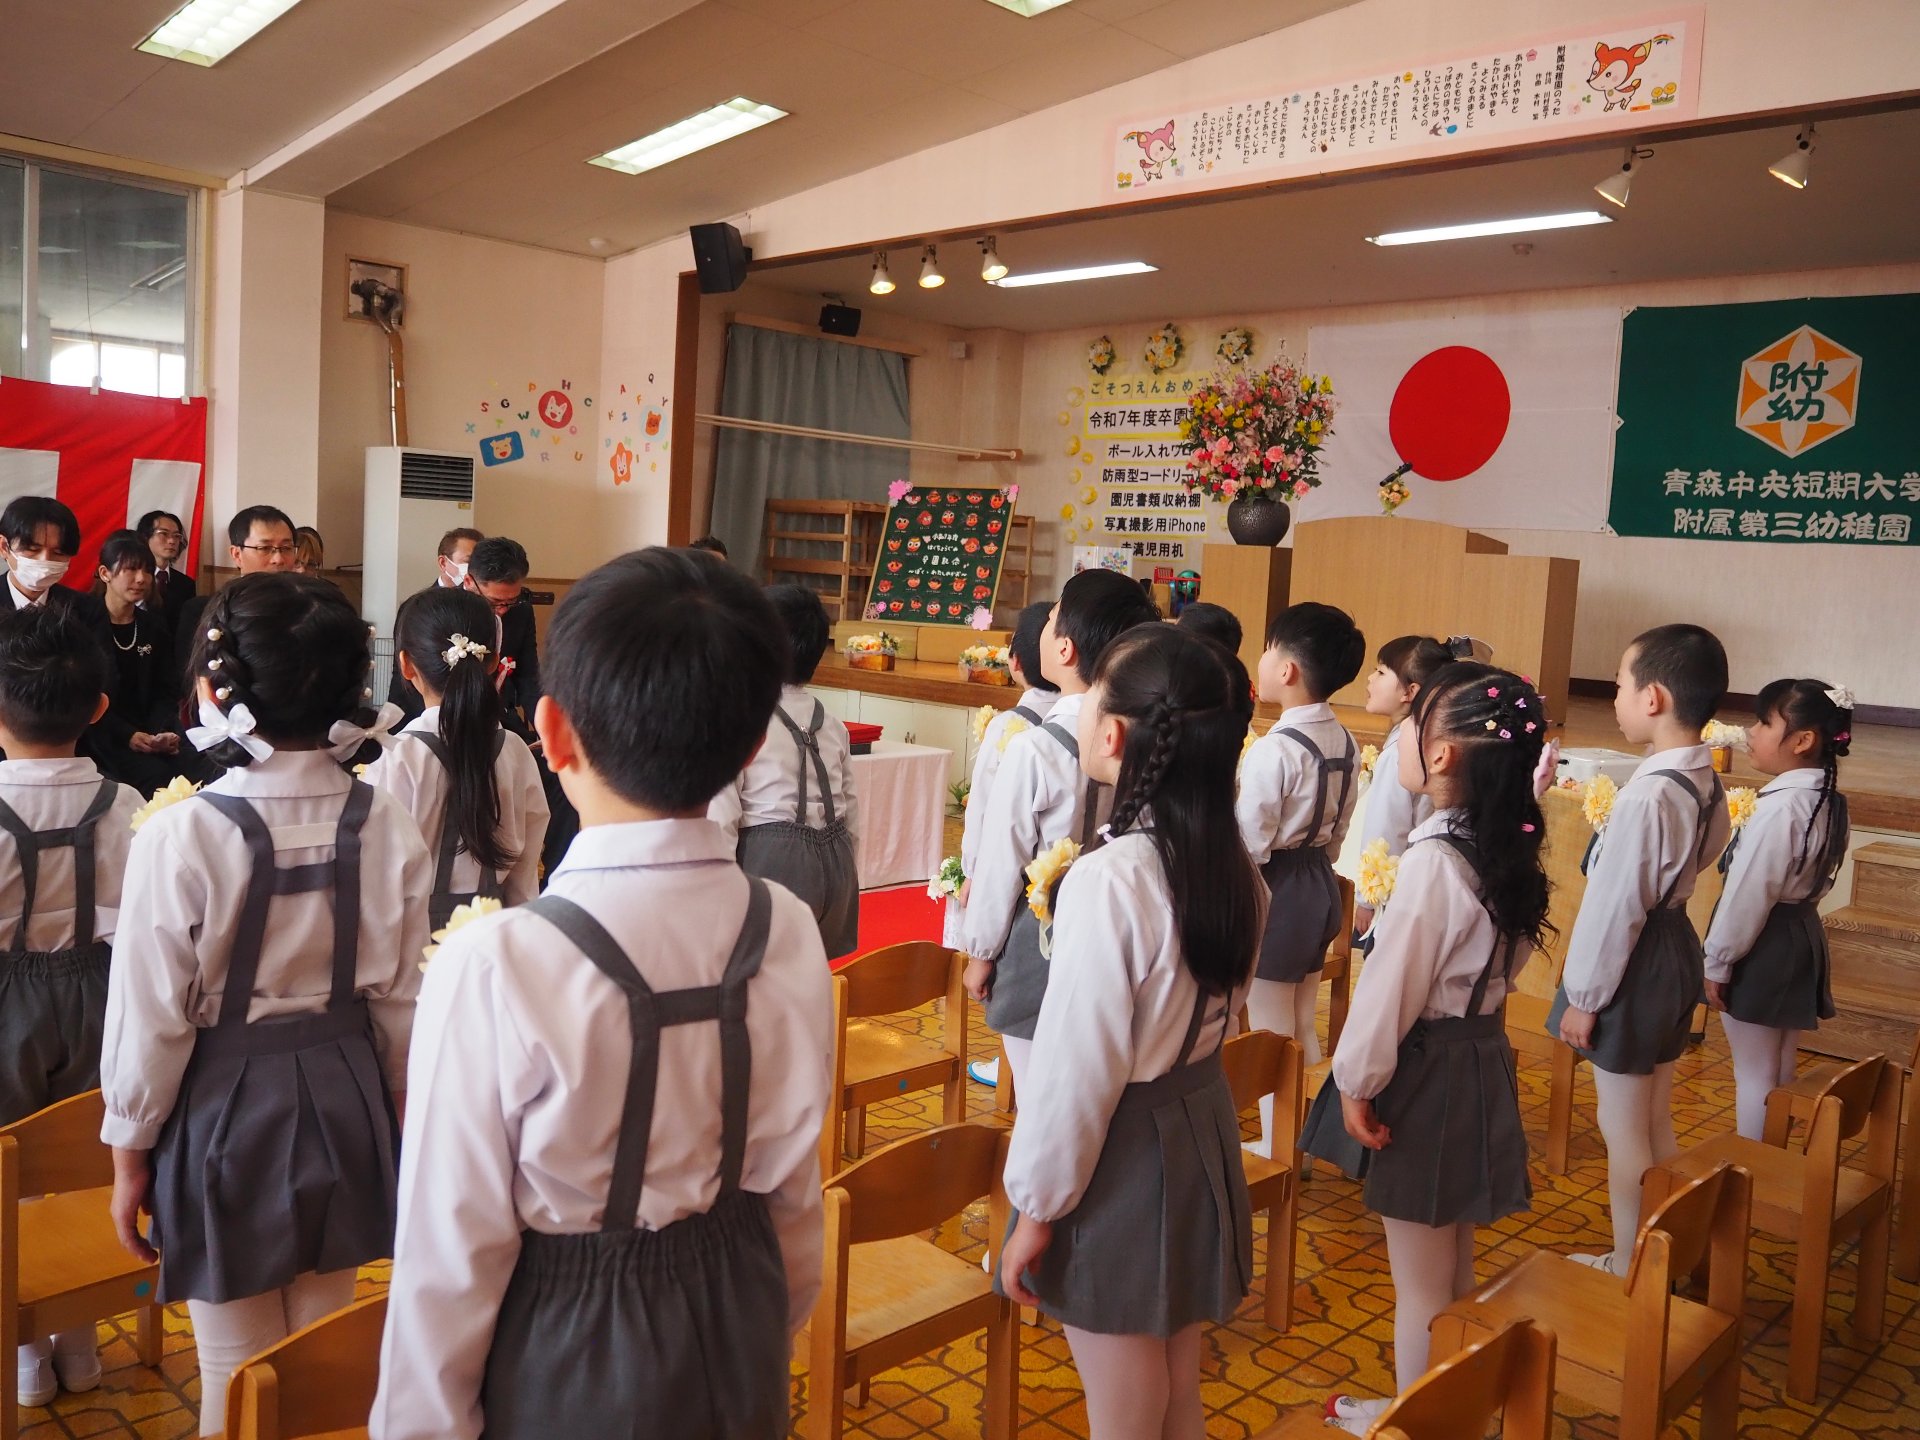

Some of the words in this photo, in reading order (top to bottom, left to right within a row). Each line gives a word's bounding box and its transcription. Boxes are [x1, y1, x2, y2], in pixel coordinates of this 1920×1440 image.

[1479, 69, 1488, 109] よくみえる
[1490, 58, 1500, 117] たかいおやまも
[1501, 65, 1510, 106] あおいそら
[1512, 54, 1522, 113] あかいおやねと
[1412, 80, 1420, 120] ようちえん
[1421, 70, 1431, 126] ひろいふぞくの
[1432, 76, 1440, 117] こんにちは
[1454, 73, 1463, 113] おともだち
[1340, 95, 1349, 132] おともだち
[1391, 76, 1400, 140] おへやもきれいに
[1302, 102, 1310, 138] ようちえん
[1321, 98, 1329, 135] こんにちは
[1191, 122, 1199, 157] ようちえん
[1235, 114, 1243, 150] おともだち
[562, 380, 571, 390] H
[648, 373, 654, 384] Q
[528, 382, 536, 392] P
[620, 384, 626, 394] A
[481, 403, 489, 412] S
[501, 398, 510, 408] G
[584, 398, 592, 407] C
[662, 397, 668, 406] Y
[518, 411, 530, 420] W
[608, 411, 614, 420] K
[622, 412, 628, 422] Z
[1089, 407, 1195, 429] 令和7年度卒園
[465, 423, 475, 433] X
[530, 428, 540, 438] N
[552, 436, 560, 445] V
[645, 443, 651, 452] E
[541, 452, 549, 462] R
[574, 451, 583, 461] U
[1103, 468, 1200, 483] 防雨型コードリー
[1662, 468, 1920, 501] 青森中央短期大学
[1111, 492, 1200, 508] 園児書類収納棚
[1674, 508, 1911, 542] 附属第三幼稚園
